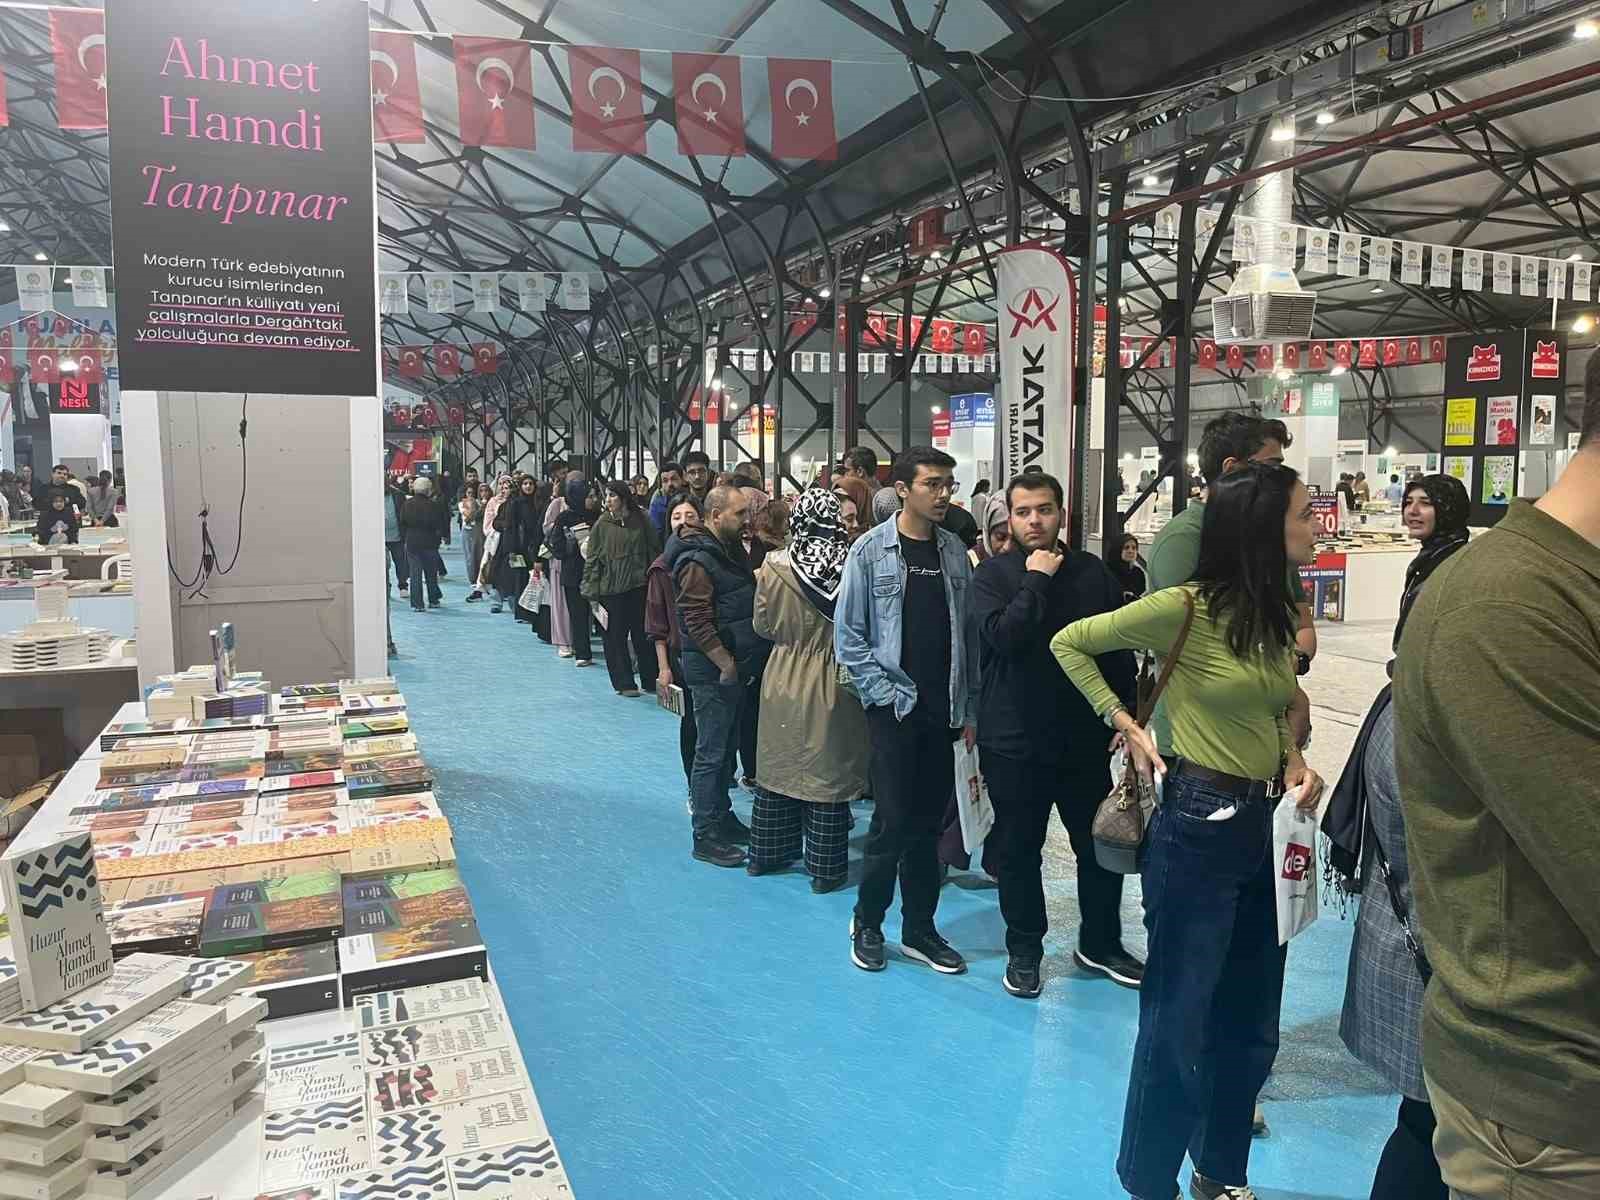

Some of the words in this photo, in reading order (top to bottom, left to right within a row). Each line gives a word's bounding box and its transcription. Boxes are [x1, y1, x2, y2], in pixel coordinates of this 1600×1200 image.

[160, 37, 320, 93] Ahmet
[160, 96, 323, 151] Hamdi
[142, 164, 348, 225] Tanpınar
[143, 254, 206, 269] Modern
[211, 257, 244, 271] Türk
[249, 261, 345, 279] edebiyatının
[168, 273, 223, 288] kurucu
[228, 276, 323, 295] isimlerinden
[149, 309, 250, 325] çalışmalarla
[246, 295, 304, 312] külliyatı
[308, 301, 340, 315] yeni
[137, 327, 239, 344] yolculuğuna
[244, 331, 299, 346] devam
[304, 333, 355, 350] ediyor.
[30, 927, 66, 953] Huzur
[56, 932, 91, 961] Ahmet
[59, 945, 96, 977] Hamdi
